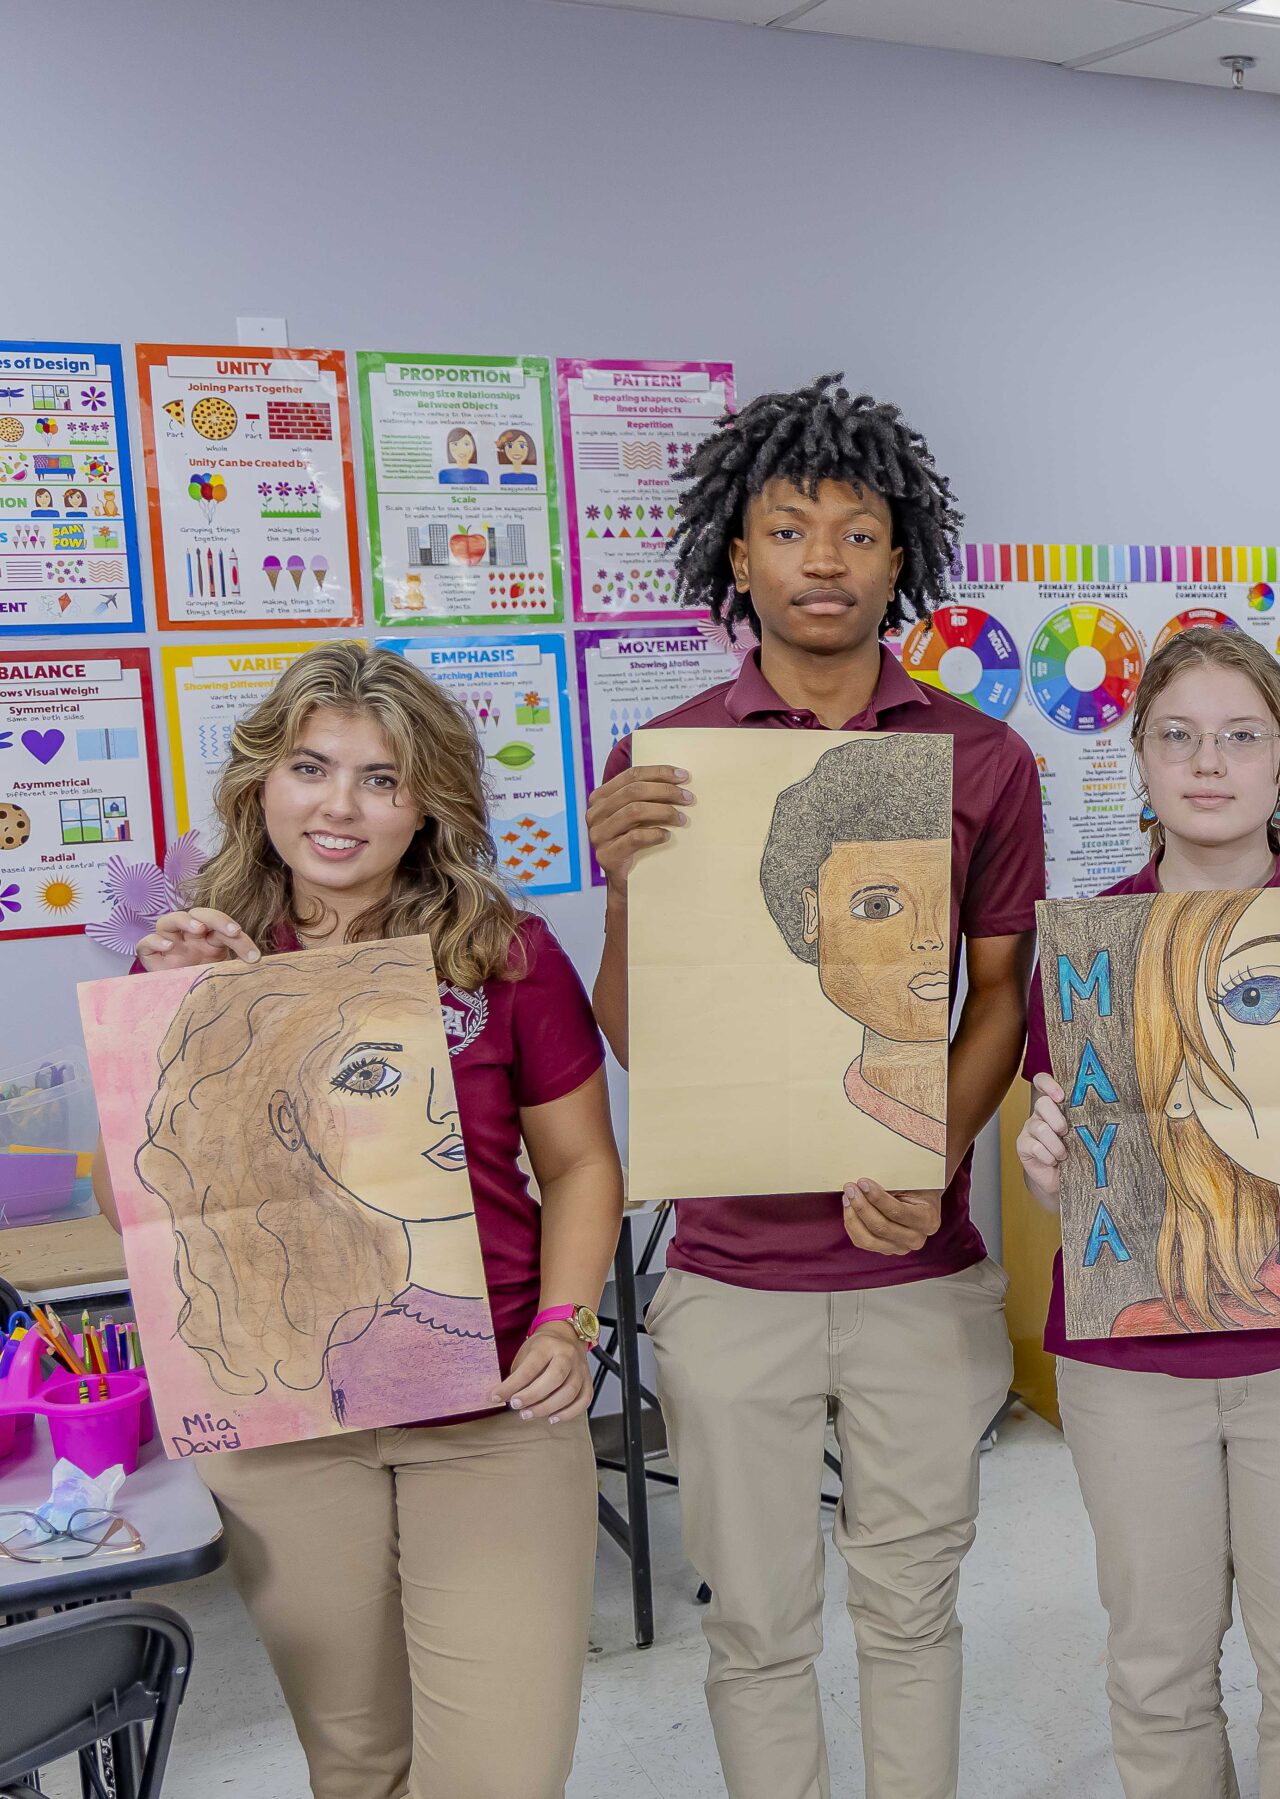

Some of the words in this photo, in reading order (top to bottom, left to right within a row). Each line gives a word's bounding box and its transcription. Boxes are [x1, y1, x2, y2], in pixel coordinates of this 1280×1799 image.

[14, 357, 30, 369] of
[34, 358, 89, 373] Design
[216, 361, 272, 375] UNITY
[400, 367, 511, 383] PROPORTION
[613, 373, 681, 387] PATTERN
[188, 383, 226, 394] Joining
[228, 384, 254, 393] Parts
[256, 385, 303, 394] Together
[392, 389, 434, 400] Showing
[436, 390, 455, 398] Size
[457, 390, 520, 400] Relationships
[593, 394, 639, 404] Repeating
[418, 400, 460, 409] Between
[463, 401, 498, 410] Objects
[649, 405, 681, 414] objects
[627, 421, 673, 430] Repetition
[189, 458, 216, 468] Unity
[240, 459, 252, 467] be
[451, 496, 477, 504] Scale
[52, 524, 85, 537] BAM!
[216, 526, 240, 534] things
[52, 538, 87, 548] POW!
[194, 535, 228, 543] together
[641, 541, 667, 550] Rhyth
[618, 640, 708, 654] MOVEMENT
[431, 649, 515, 664] EMPHASIS
[630, 660, 667, 669] Showing
[0, 664, 86, 679] BALANCE
[473, 670, 518, 678] Attention
[184, 681, 229, 691] Showing
[230, 679, 274, 689] Different
[24, 688, 58, 697] Visual
[60, 687, 99, 697] Weight
[9, 704, 80, 715] Symmetrical
[13, 778, 90, 790] Asymmetrical
[6, 790, 46, 798] Different
[489, 793, 506, 801] OW!
[513, 791, 531, 799] BUY
[534, 790, 558, 798] NOW!
[41, 853, 75, 863] Radial
[66, 861, 94, 869] central
[1057, 950, 1132, 1267] MAYA
[182, 1412, 236, 1436] Mia
[172, 1432, 242, 1457] David
